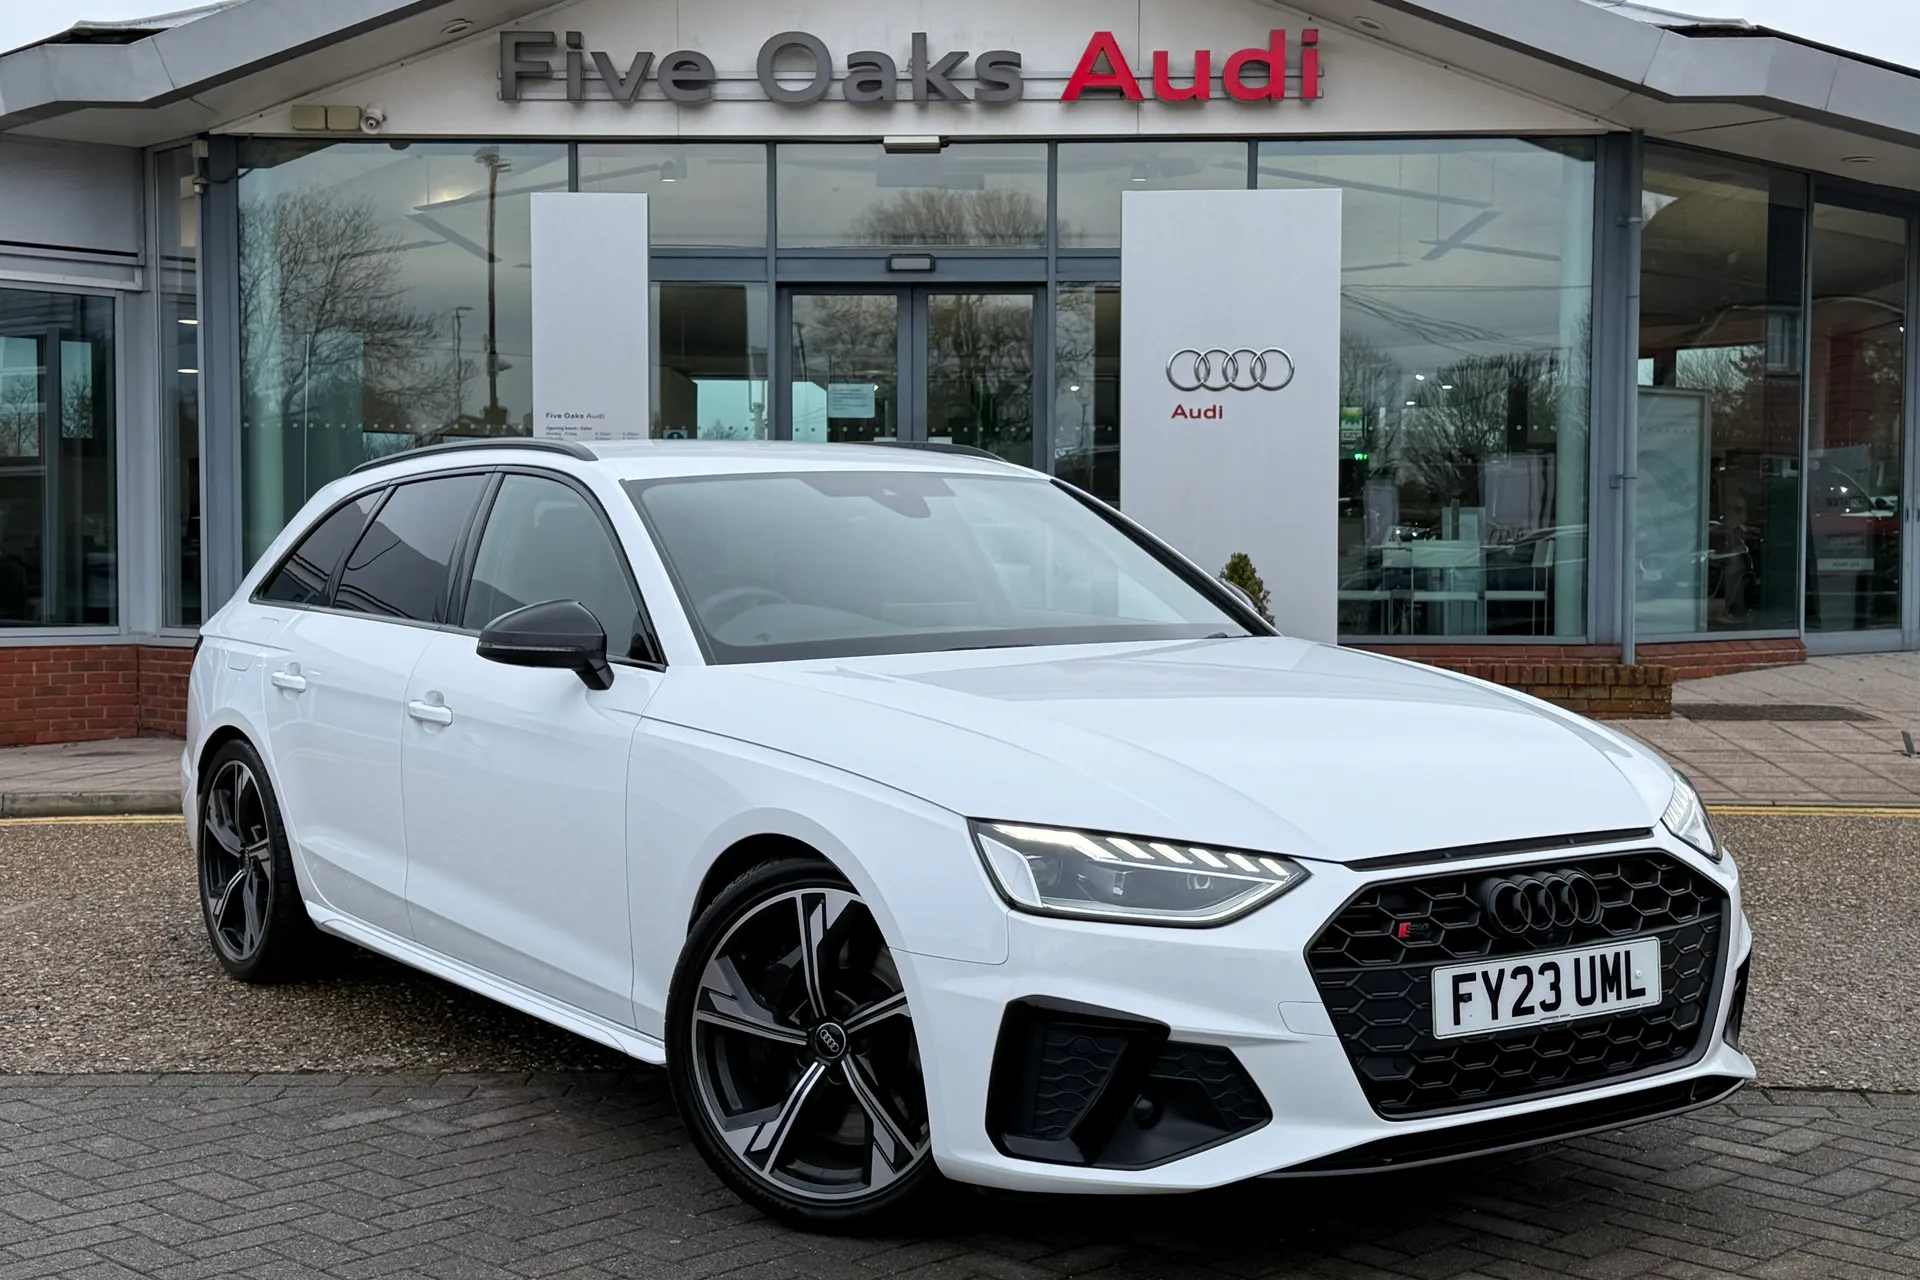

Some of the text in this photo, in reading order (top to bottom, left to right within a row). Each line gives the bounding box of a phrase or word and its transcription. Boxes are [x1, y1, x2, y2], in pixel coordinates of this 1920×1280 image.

[499, 29, 1319, 105] Five Oaks Audi
[586, 412, 605, 420] Audi
[1171, 404, 1223, 419] Audi
[1452, 950, 1647, 1026] FY23 UML
